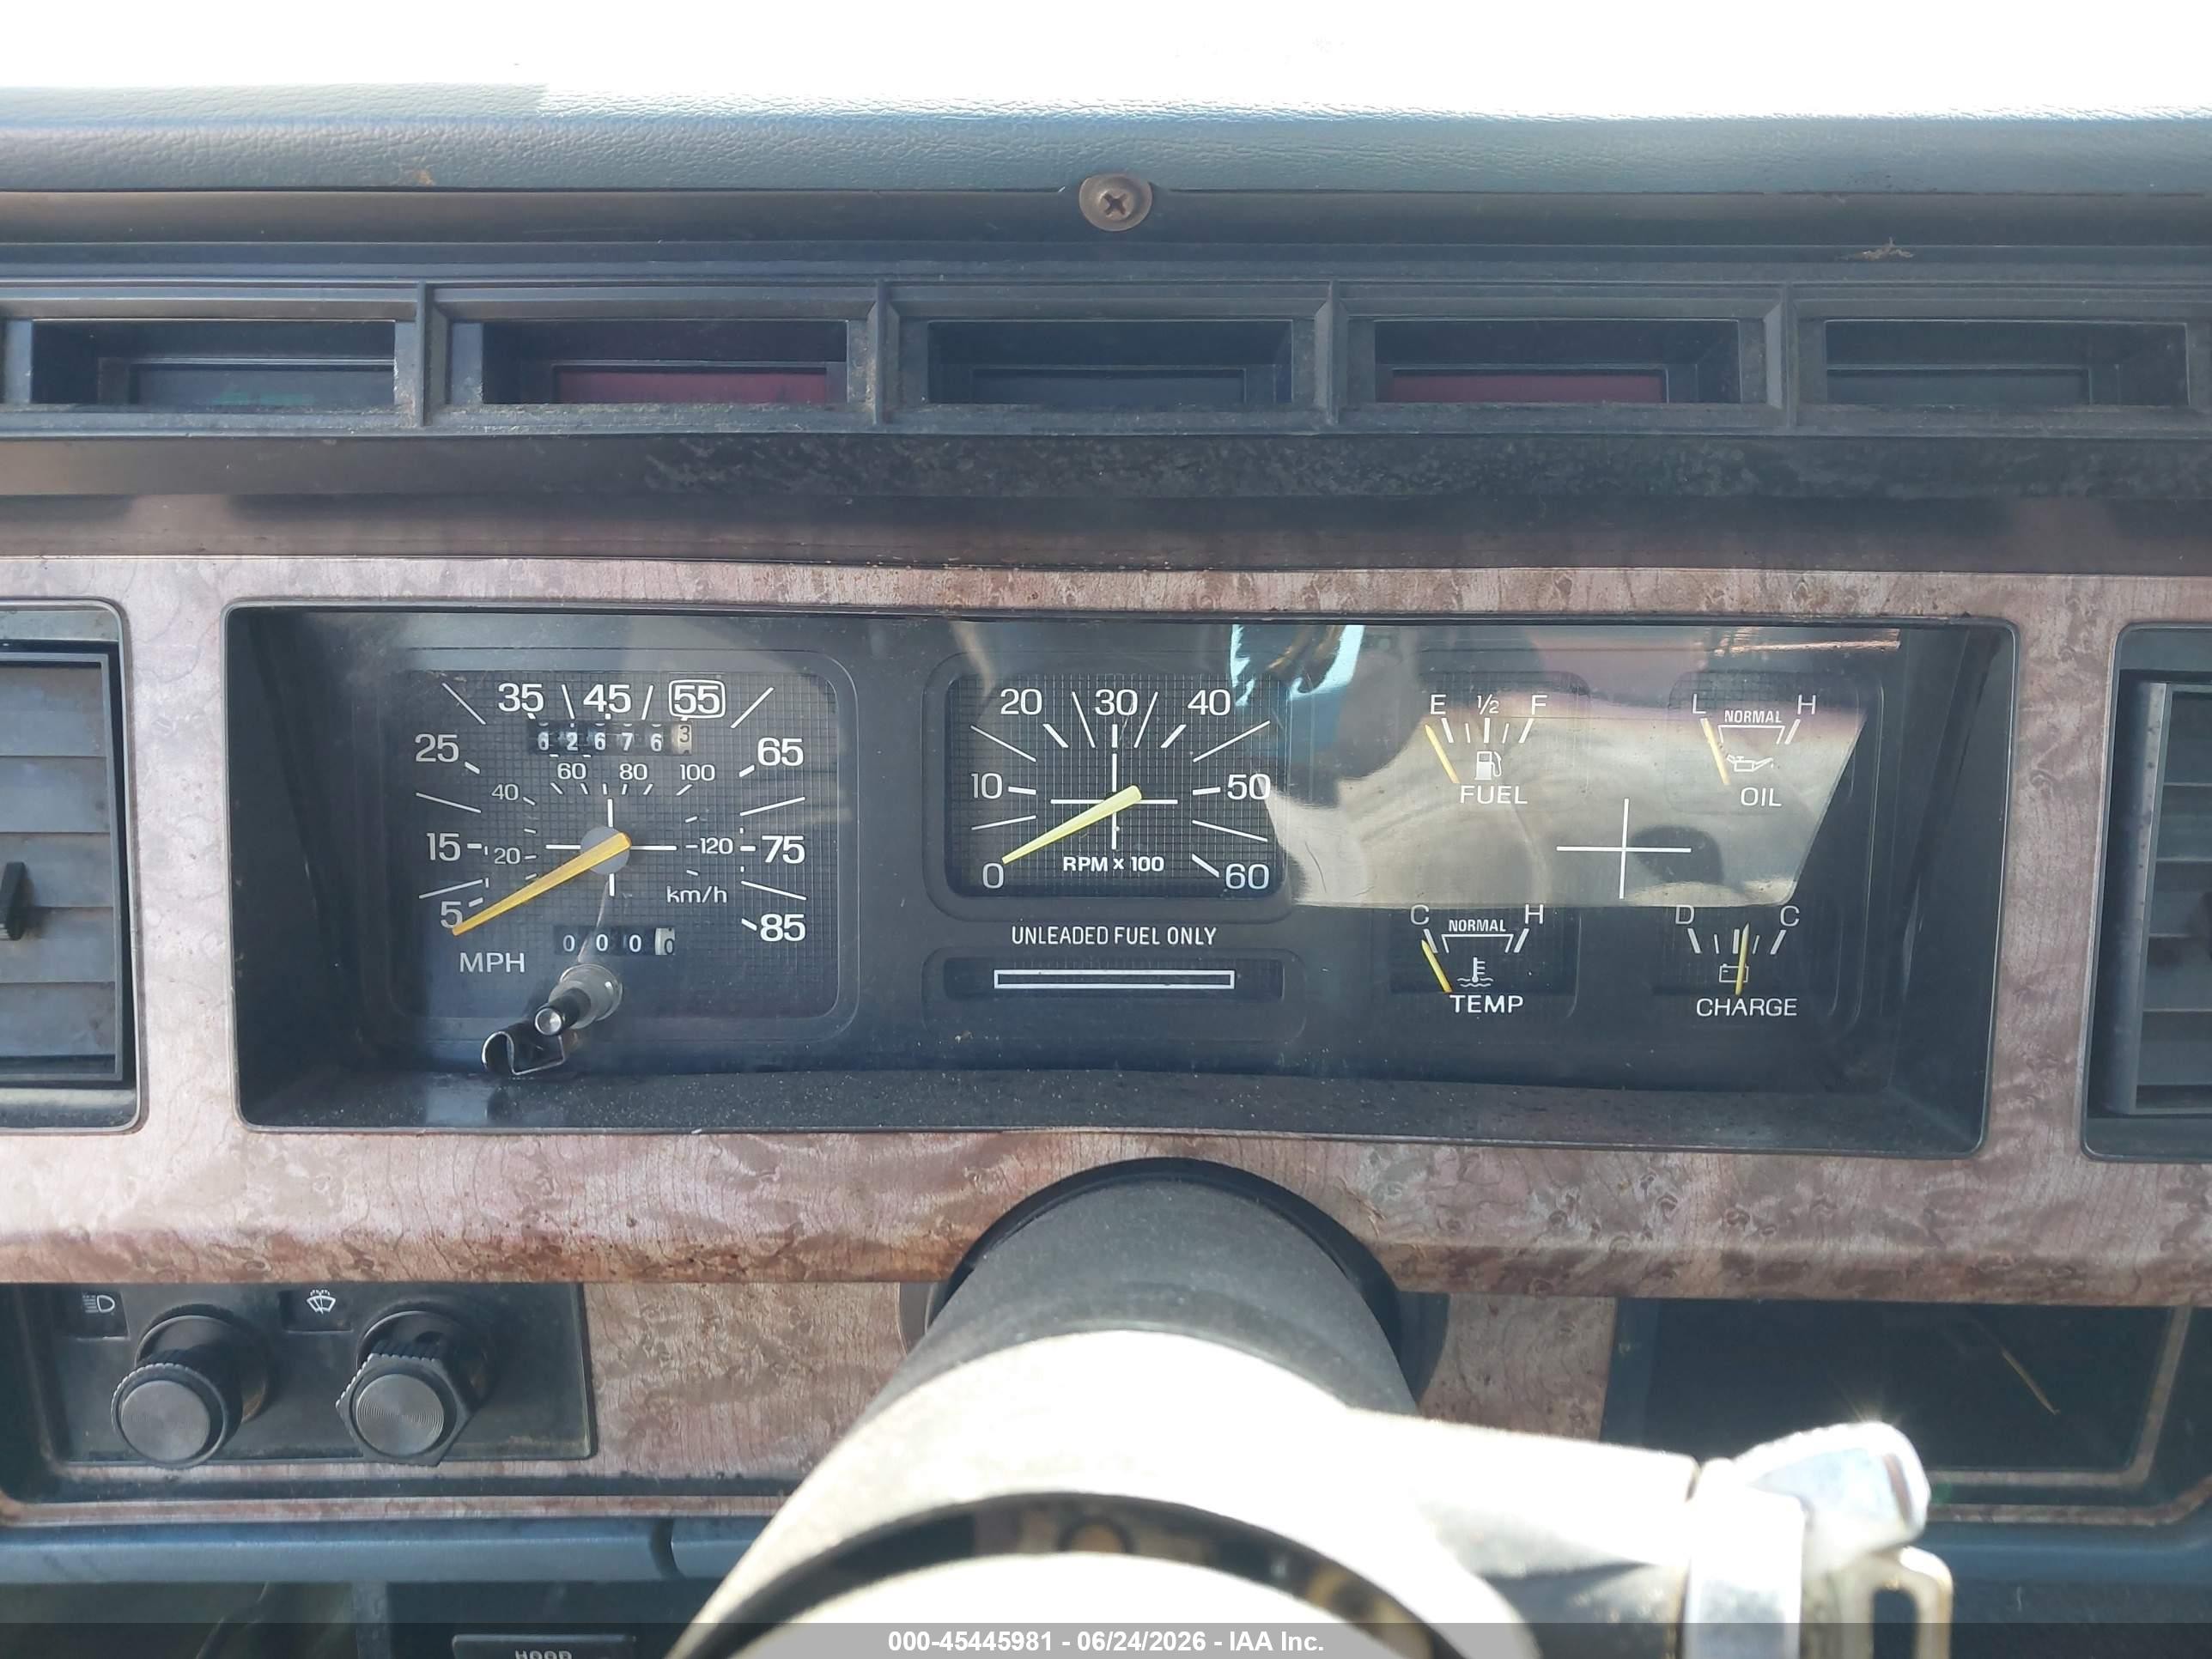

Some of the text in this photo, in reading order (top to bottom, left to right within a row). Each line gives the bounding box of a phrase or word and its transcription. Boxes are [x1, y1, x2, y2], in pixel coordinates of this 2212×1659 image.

[498, 683, 544, 713] 35
[583, 684, 631, 714] 45
[674, 684, 720, 714] 55
[1000, 689, 1042, 715] 20
[1095, 690, 1138, 715] 30
[1188, 690, 1231, 716] 40
[1430, 695, 1446, 714] E
[1531, 695, 1547, 714] F
[1692, 695, 1707, 714] L
[1798, 696, 1816, 714] H
[1724, 709, 1782, 724] NORMAL
[415, 734, 460, 763] 25
[757, 738, 804, 767] 65
[556, 763, 586, 781] 60
[619, 763, 648, 781] 80
[679, 764, 715, 781] 100
[491, 784, 519, 801] 40
[971, 773, 1003, 799] 10
[1227, 775, 1271, 800] 50
[1461, 787, 1527, 804] FUEL
[1741, 788, 1782, 806] OIL
[427, 832, 460, 860] 15
[700, 837, 733, 854] 120
[761, 836, 805, 864] 75
[494, 848, 520, 865] 20
[1063, 857, 1108, 872] RPM
[1131, 857, 1164, 872] 100
[982, 863, 1004, 889] 0
[1225, 864, 1269, 890] 60
[666, 885, 727, 904] km/h
[440, 901, 464, 929] 5
[1410, 905, 1430, 925] C
[1525, 904, 1544, 924] H
[1676, 905, 1695, 924] D
[1780, 906, 1800, 927] C
[760, 914, 805, 942] 85
[1449, 918, 1506, 933] NORMAL
[1012, 927, 1217, 945] UNLEADED FUEL ONLY
[459, 952, 526, 973] MPH
[1449, 995, 1523, 1013] TEMP
[1696, 998, 1797, 1017] CHARGE
